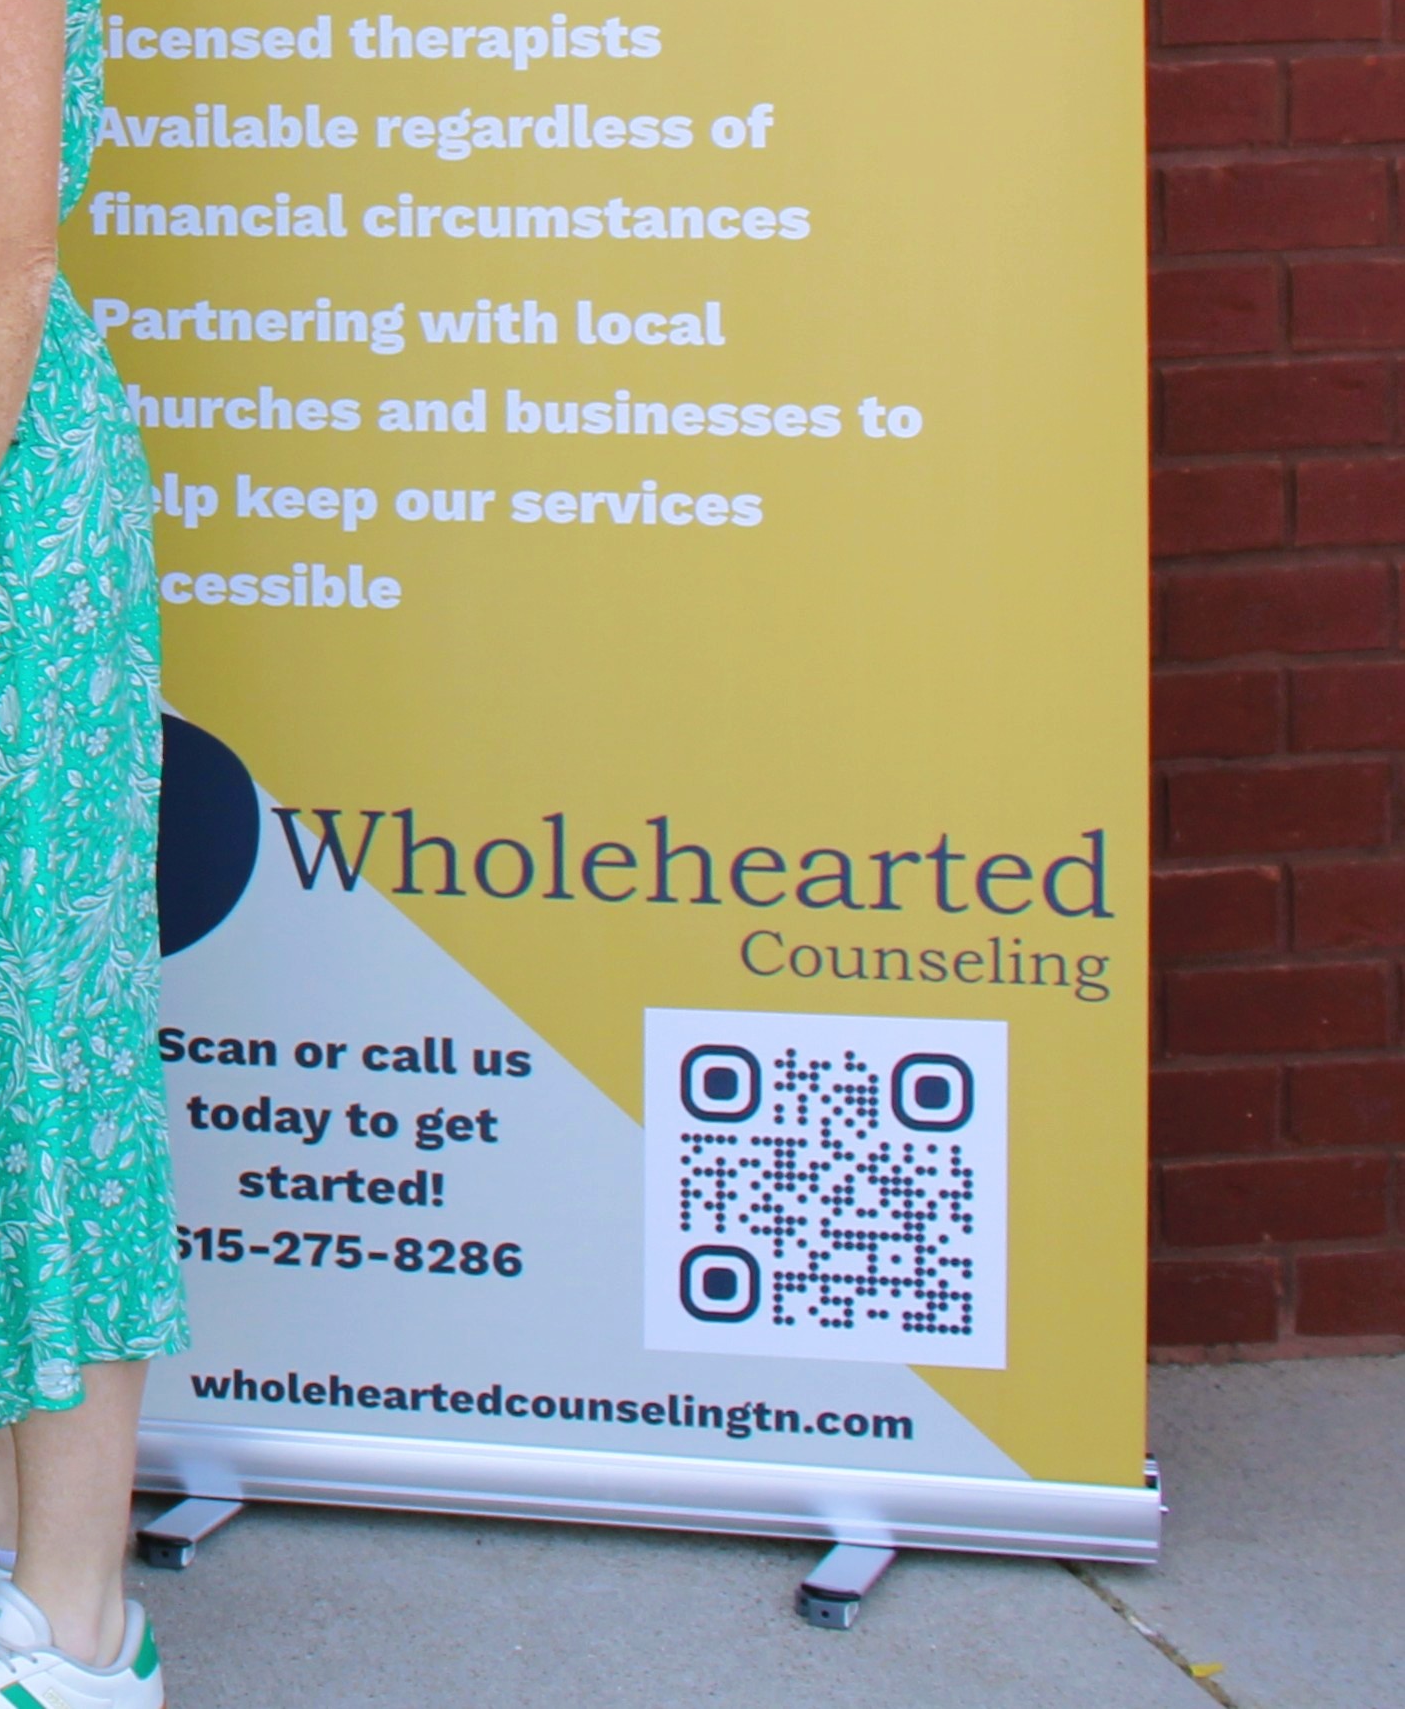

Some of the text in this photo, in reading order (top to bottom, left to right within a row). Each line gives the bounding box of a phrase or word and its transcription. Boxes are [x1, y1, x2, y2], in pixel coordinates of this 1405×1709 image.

[101, 12, 663, 71] icensed therapists
[95, 103, 775, 161] Available regardless of
[90, 191, 812, 240] financial circumstances
[92, 297, 726, 355] Partnering with local
[128, 384, 923, 438] hurches and businesses to
[151, 473, 764, 532] lp keep our services
[160, 562, 403, 609] cessible
[271, 806, 1116, 920] Wholehearted
[739, 929, 1112, 1002] Counseling
[158, 1027, 532, 1078] Scan or call us
[186, 1095, 498, 1151] today to get
[238, 1165, 446, 1207] started!
[191, 1369, 914, 1441] wholeheartedcounselingtn.com
